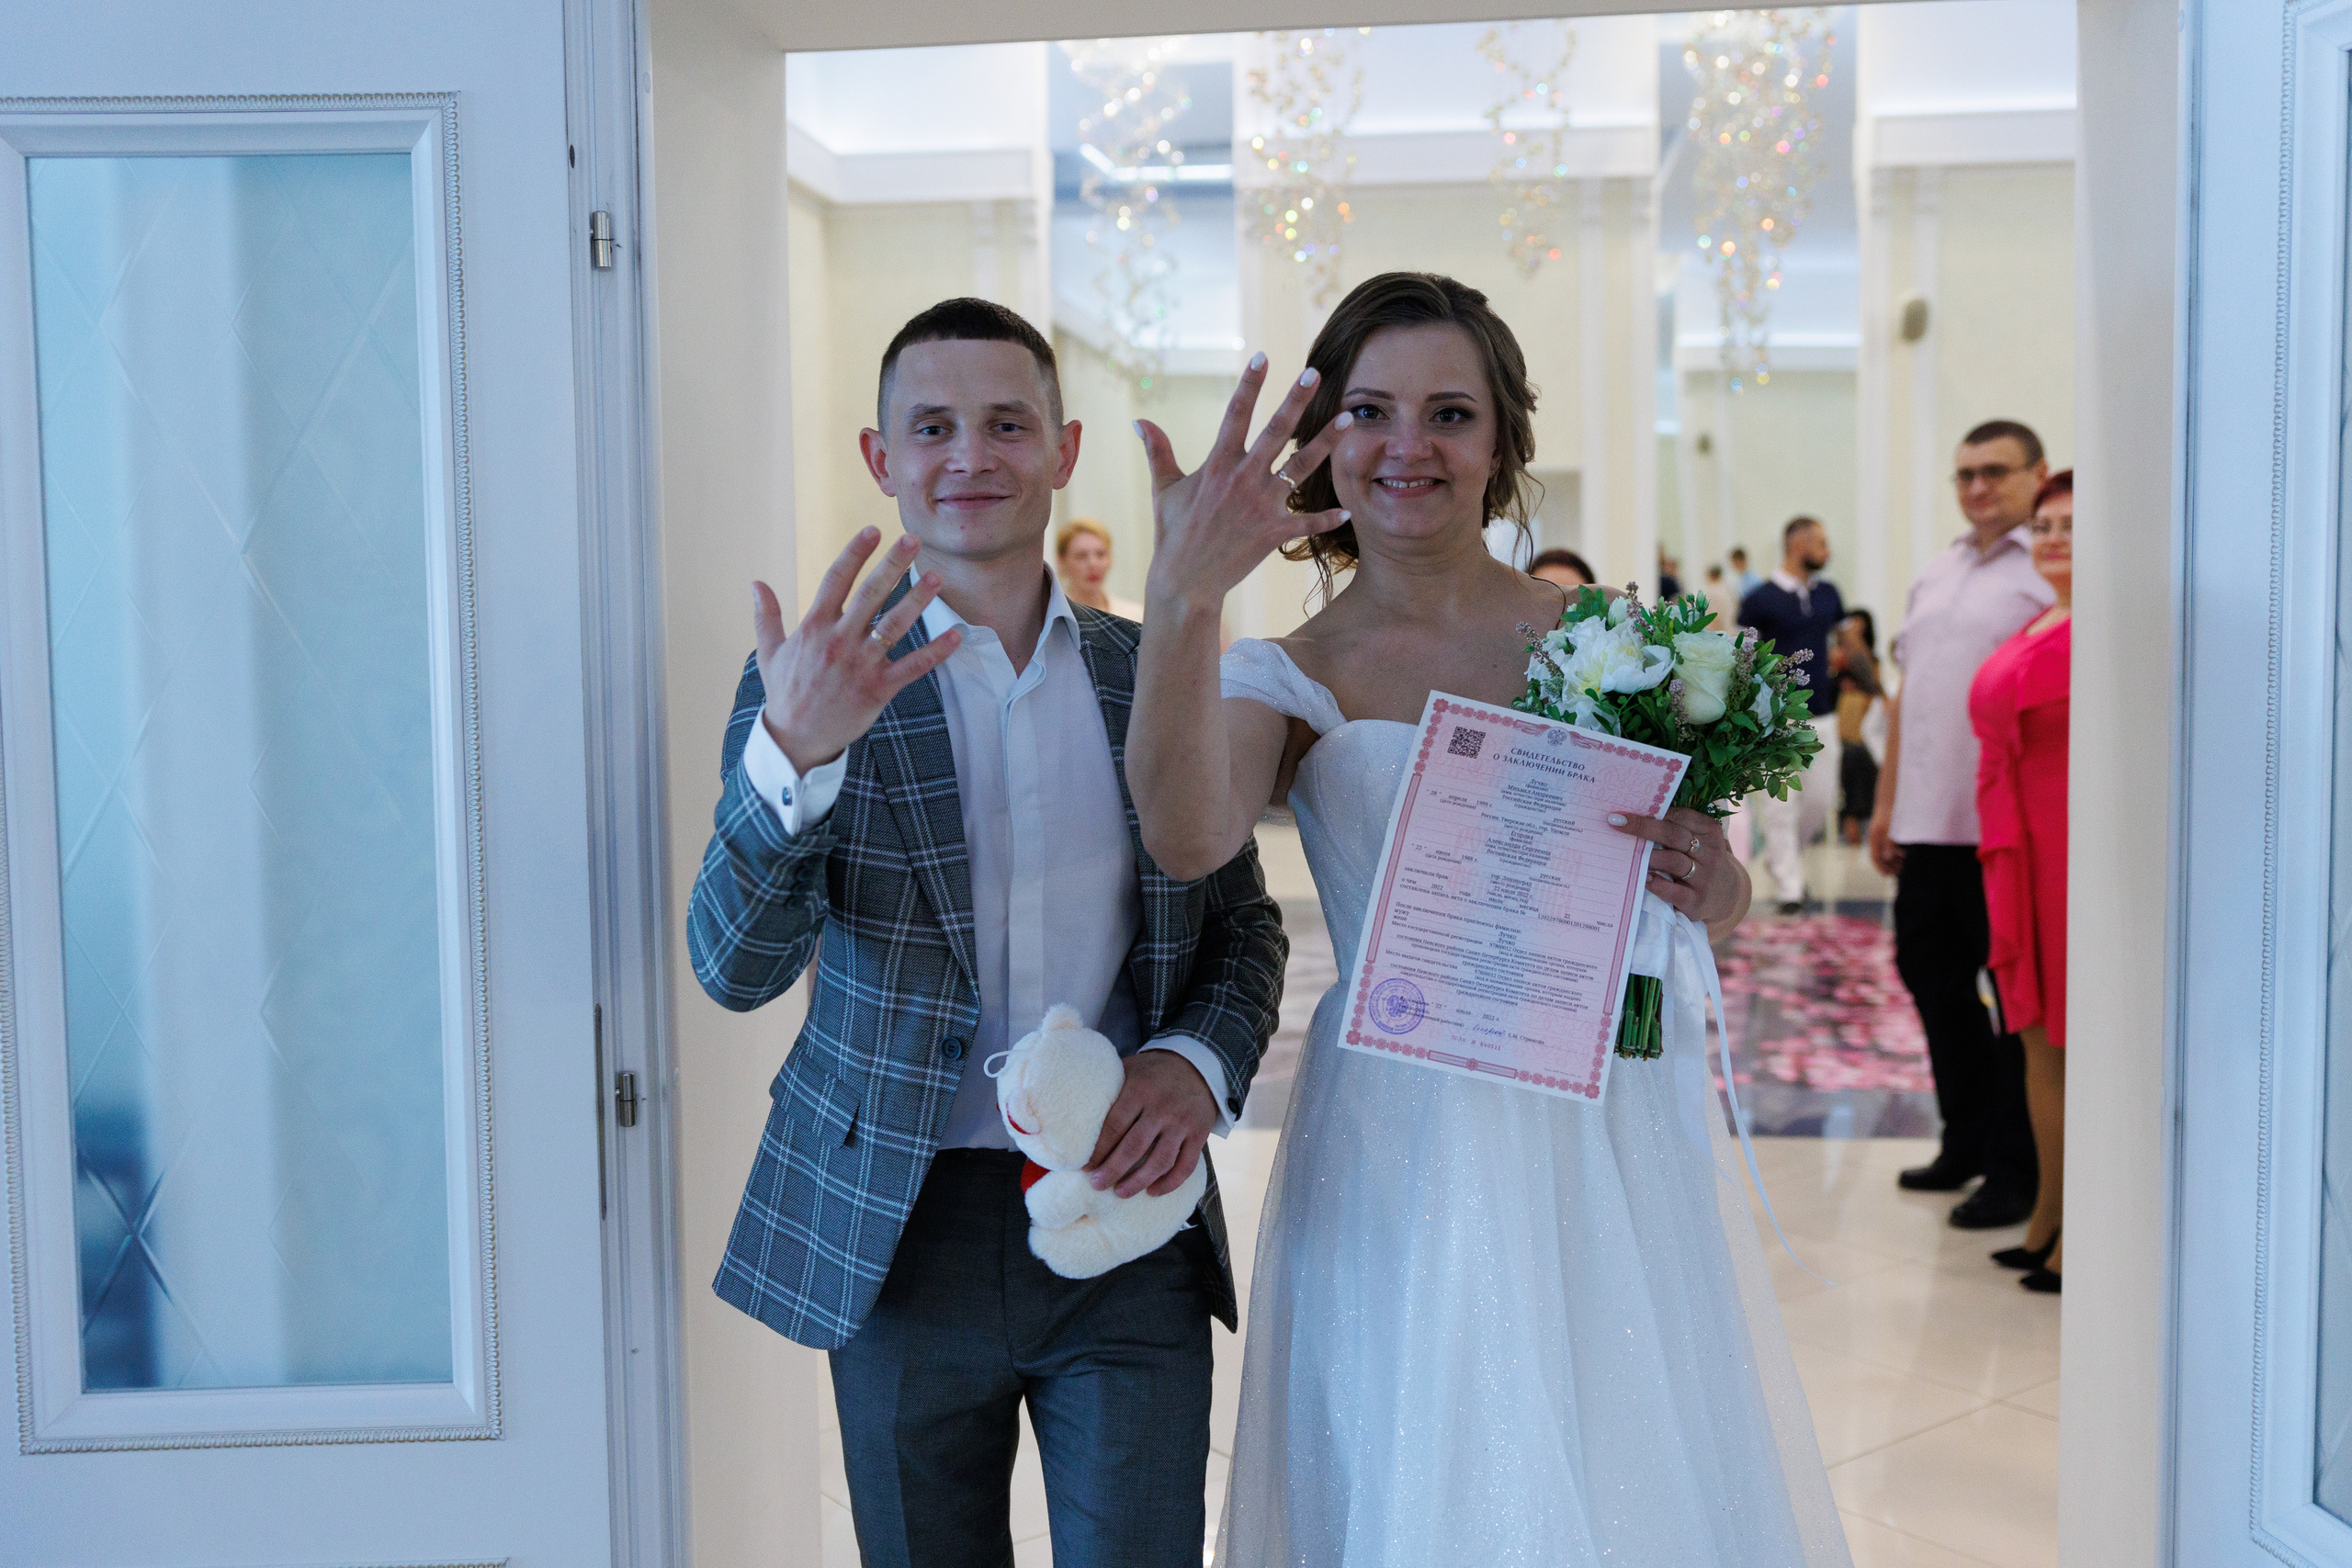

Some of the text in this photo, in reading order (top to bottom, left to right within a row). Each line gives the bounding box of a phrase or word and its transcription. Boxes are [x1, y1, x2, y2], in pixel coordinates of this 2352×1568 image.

[1510, 746, 1585, 772] СВИДЕТЕЛЬСТВО
[1492, 752, 1596, 784] О ЗАКЛЮЧЕНИИ БРАКА
[1525, 783, 1548, 793] (фамилия)
[1529, 778, 1548, 787] Лучко
[1447, 794, 1467, 803] апреля
[1507, 784, 1563, 802] Михаил Андреевич
[1452, 800, 1476, 810] рождения)
[1501, 794, 1561, 813] Российская Федерация
[1513, 802, 1546, 815] (гражданство)
[1480, 811, 1499, 820] Россия,
[1500, 816, 1525, 827] Тверская
[1549, 827, 1569, 836] Удомля
[1542, 819, 1583, 834] (национальность)
[1553, 817, 1575, 827] русский
[1510, 830, 1533, 840] Егорова
[1519, 826, 1544, 836] рождения)
[1487, 837, 1551, 856] Александра Сергеевна
[1509, 836, 1532, 845] (фамилия)
[1437, 855, 1462, 865] рождения)
[1487, 848, 1546, 867] Российская Федерация
[1498, 857, 1532, 869] (гражданство)
[1404, 865, 1449, 880] заключили брак
[1502, 875, 1532, 886] Ленинград
[1540, 873, 1561, 882] русская
[1528, 875, 1570, 889] (национальность)
[1399, 883, 1430, 894] составлена
[1430, 890, 1450, 898] запись
[1467, 897, 1502, 910] заключении
[1502, 906, 1519, 914] брака
[1519, 903, 1538, 912] месяца
[1393, 908, 1517, 940] мужу Лучко
[1395, 901, 1521, 934] После заключения брака присвоены фамилии:
[1391, 919, 1407, 928] Место
[1407, 923, 1450, 938] государственной
[1450, 933, 1483, 945] регистрации
[1511, 947, 1527, 955] Отдел
[1528, 951, 1545, 959] записи
[1562, 957, 1598, 971] гражданского
[1496, 937, 1515, 946] Лучко
[1396, 933, 1421, 942] состояния
[1422, 939, 1445, 948] Невского
[1445, 944, 1464, 953] района
[1510, 958, 1535, 968] Комитета
[1544, 965, 1559, 974] делам
[1559, 969, 1577, 977] записи
[1410, 942, 1440, 953] произведена
[1440, 949, 1478, 962] государственная
[1520, 965, 1552, 977] гражданского
[1552, 973, 1578, 983] состояния)
[1513, 953, 1547, 964] наименование
[1547, 961, 1566, 969] органа,
[1566, 964, 1587, 973] которым
[1401, 953, 1420, 961] выдачи
[1421, 957, 1457, 969] свидетельства
[1513, 977, 1531, 986] записи
[1546, 984, 1582, 998] гражданского
[1462, 960, 1523, 977] гражданского состояния
[1389, 962, 1416, 972] состояния
[1416, 967, 1439, 976] Невского
[1440, 973, 1458, 982] района
[1505, 987, 1530, 997] Комитета
[1555, 998, 1572, 1006] записи
[1399, 970, 1433, 981] свидетельство
[1437, 978, 1476, 991] государственной
[1476, 987, 1507, 998] регистрации
[1519, 996, 1551, 1008] гражданского
[1551, 1003, 1577, 1013] состояния)
[1489, 977, 1523, 989] наименование
[1523, 985, 1541, 993] органа,
[1542, 989, 1563, 998] которым
[1563, 994, 1581, 1002] выдано
[1455, 988, 1518, 1006] гражданского состояния
[1440, 1018, 1464, 1028] работник)
